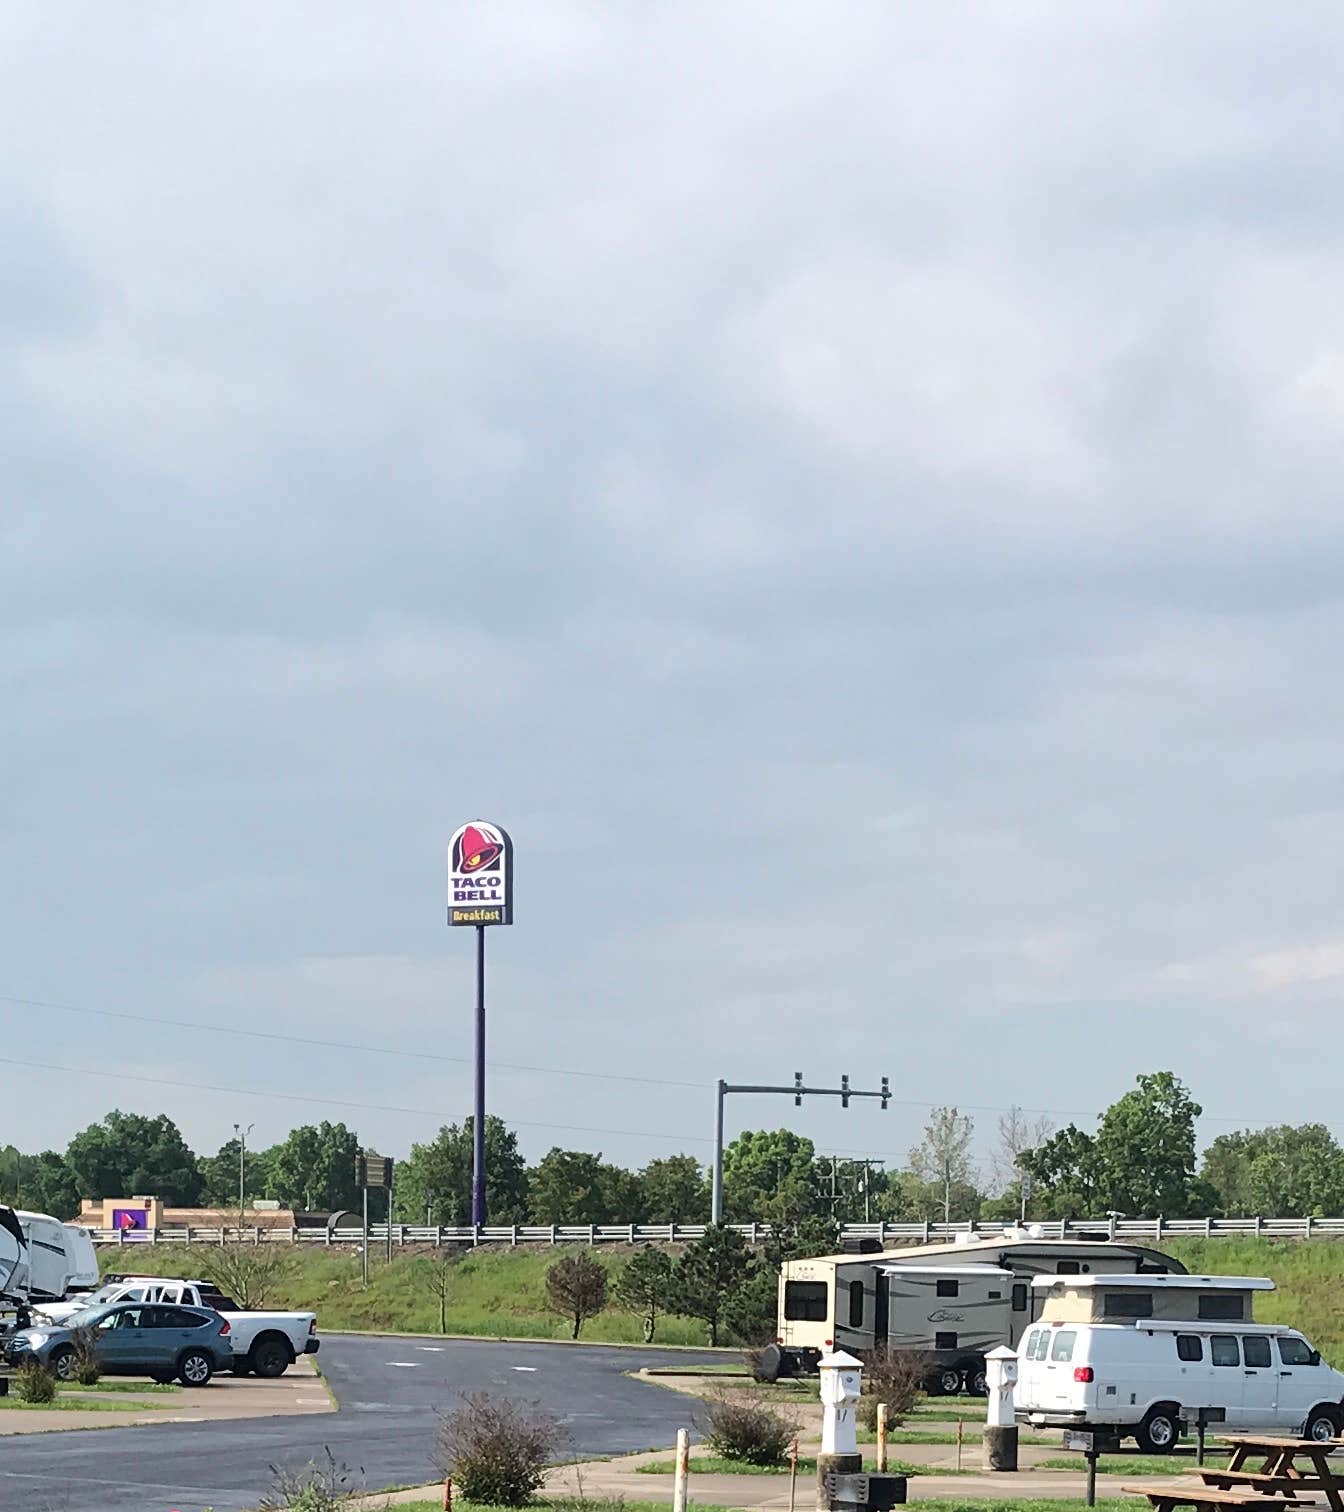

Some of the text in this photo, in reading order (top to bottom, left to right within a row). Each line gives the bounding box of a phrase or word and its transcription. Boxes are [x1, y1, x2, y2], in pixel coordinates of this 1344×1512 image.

[451, 877, 501, 888] TACO
[454, 890, 501, 901] BELL
[453, 909, 500, 921] Breakfast
